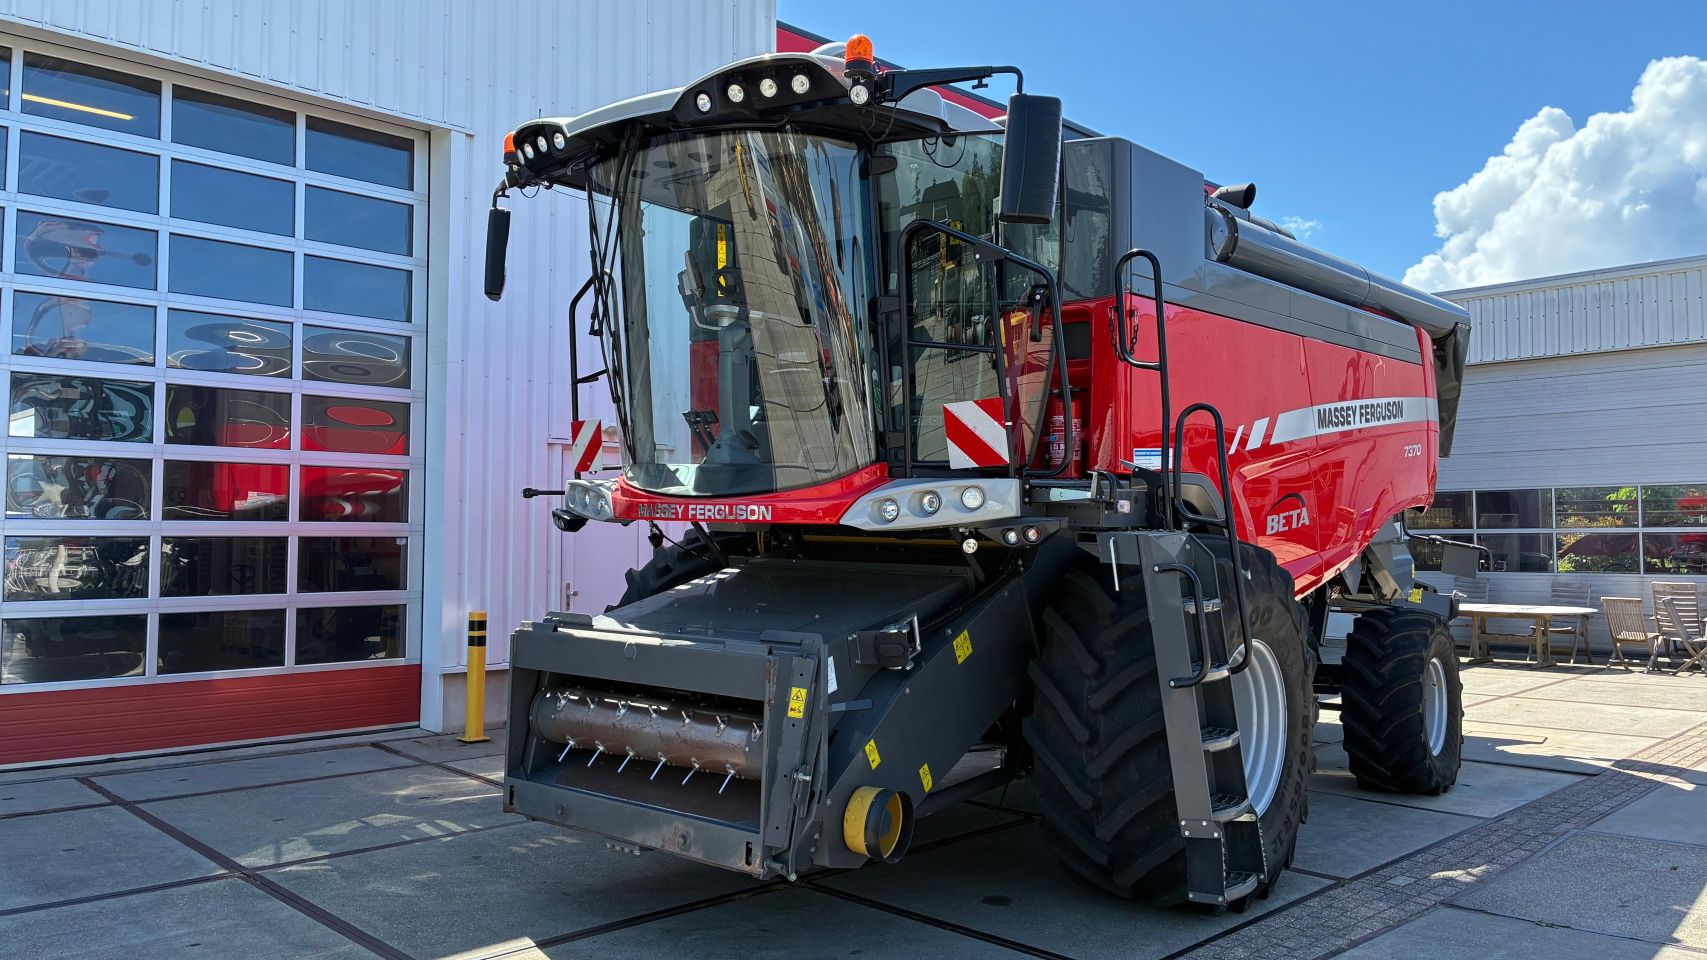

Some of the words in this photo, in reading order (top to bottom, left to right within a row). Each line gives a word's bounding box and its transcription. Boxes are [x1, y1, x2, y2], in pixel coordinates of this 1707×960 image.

[1318, 406, 1357, 429] MASSEY
[1359, 401, 1403, 423] FERGUSON
[1404, 444, 1421, 457] 7370
[639, 503, 684, 518] MASSEY
[688, 505, 771, 520] FERGUSON
[1267, 509, 1309, 535] BETA
